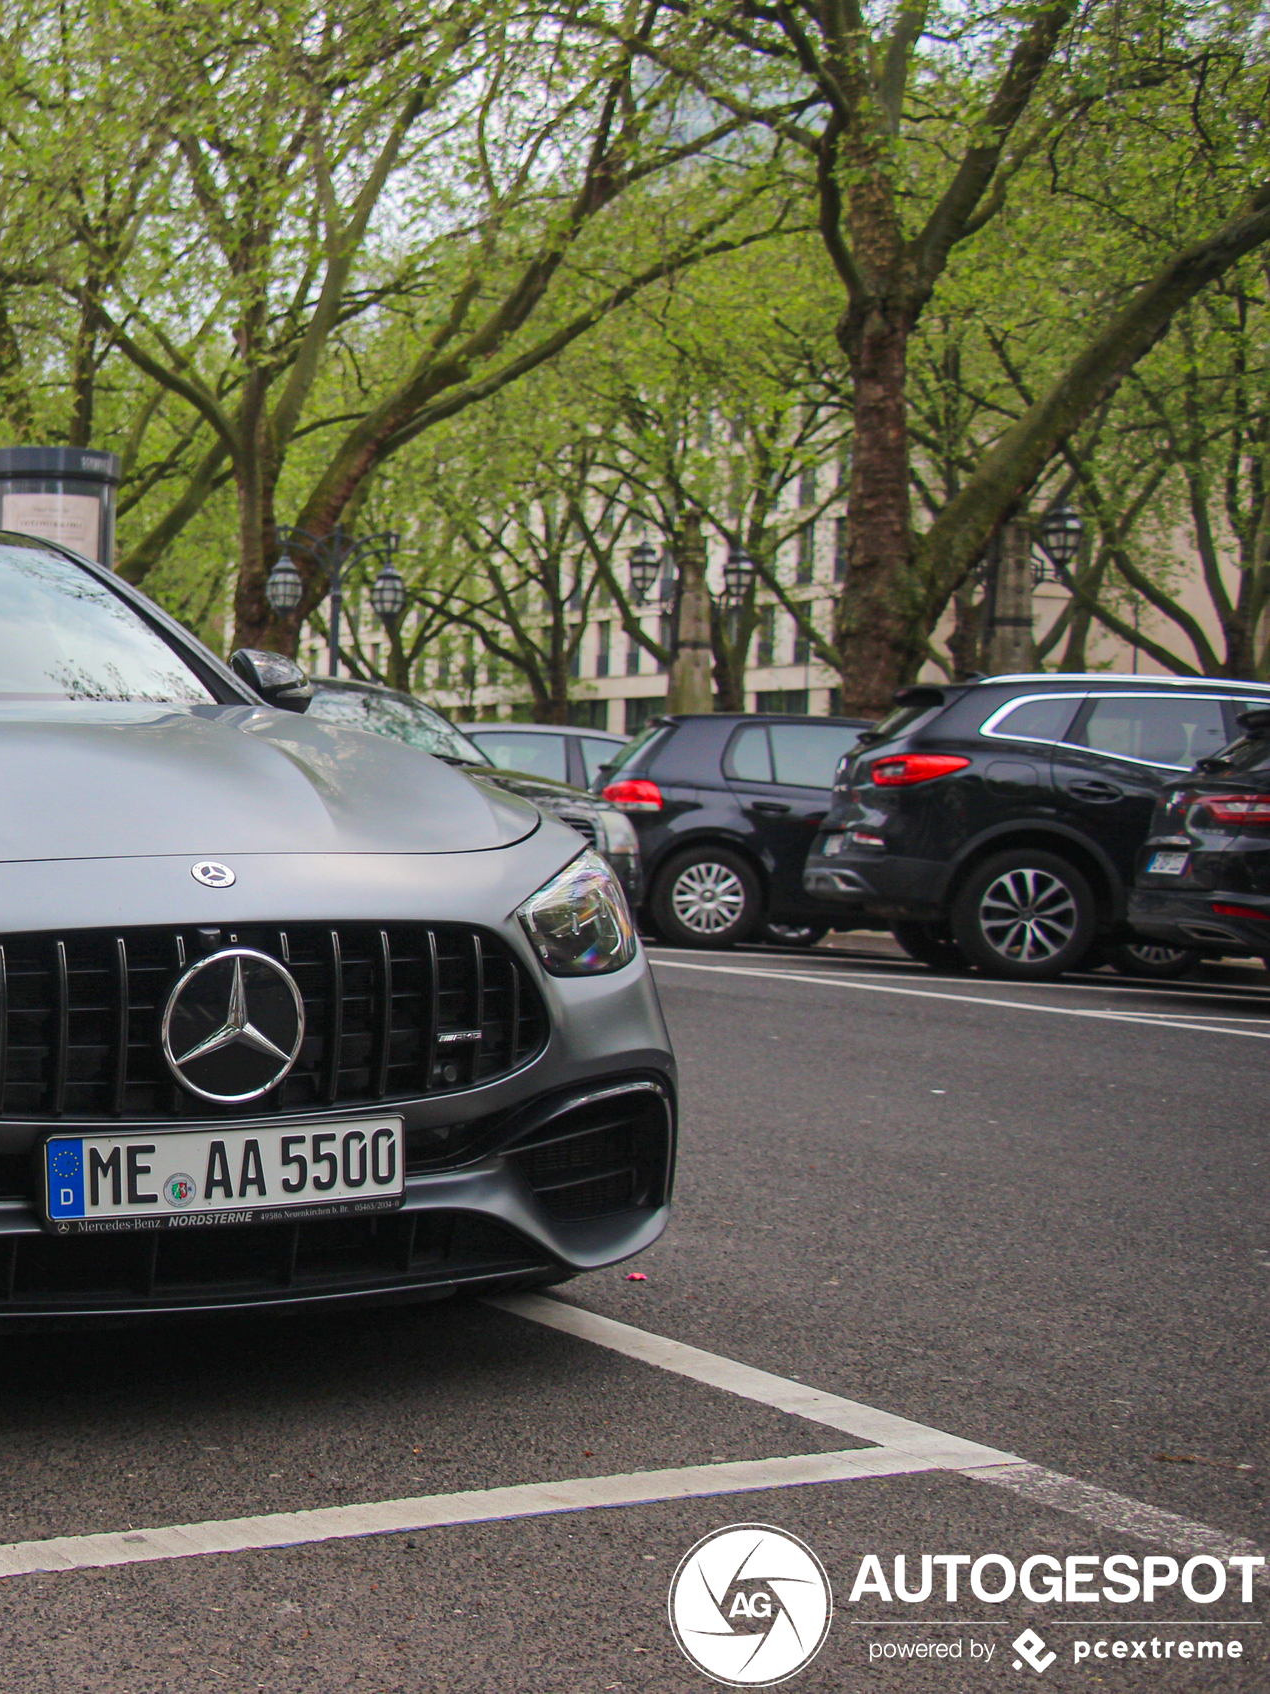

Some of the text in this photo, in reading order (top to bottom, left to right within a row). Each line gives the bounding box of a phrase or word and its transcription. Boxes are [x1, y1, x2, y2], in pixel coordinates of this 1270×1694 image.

[60, 1188, 74, 1206] D
[89, 1144, 159, 1206] ME
[204, 1138, 267, 1200] AA
[281, 1128, 397, 1194] 5500
[78, 1218, 162, 1233] Mercedes-Benz
[168, 1211, 253, 1227] NORDSTERNE
[260, 1211, 283, 1221] 49586
[284, 1206, 331, 1219] Neuenkirchen
